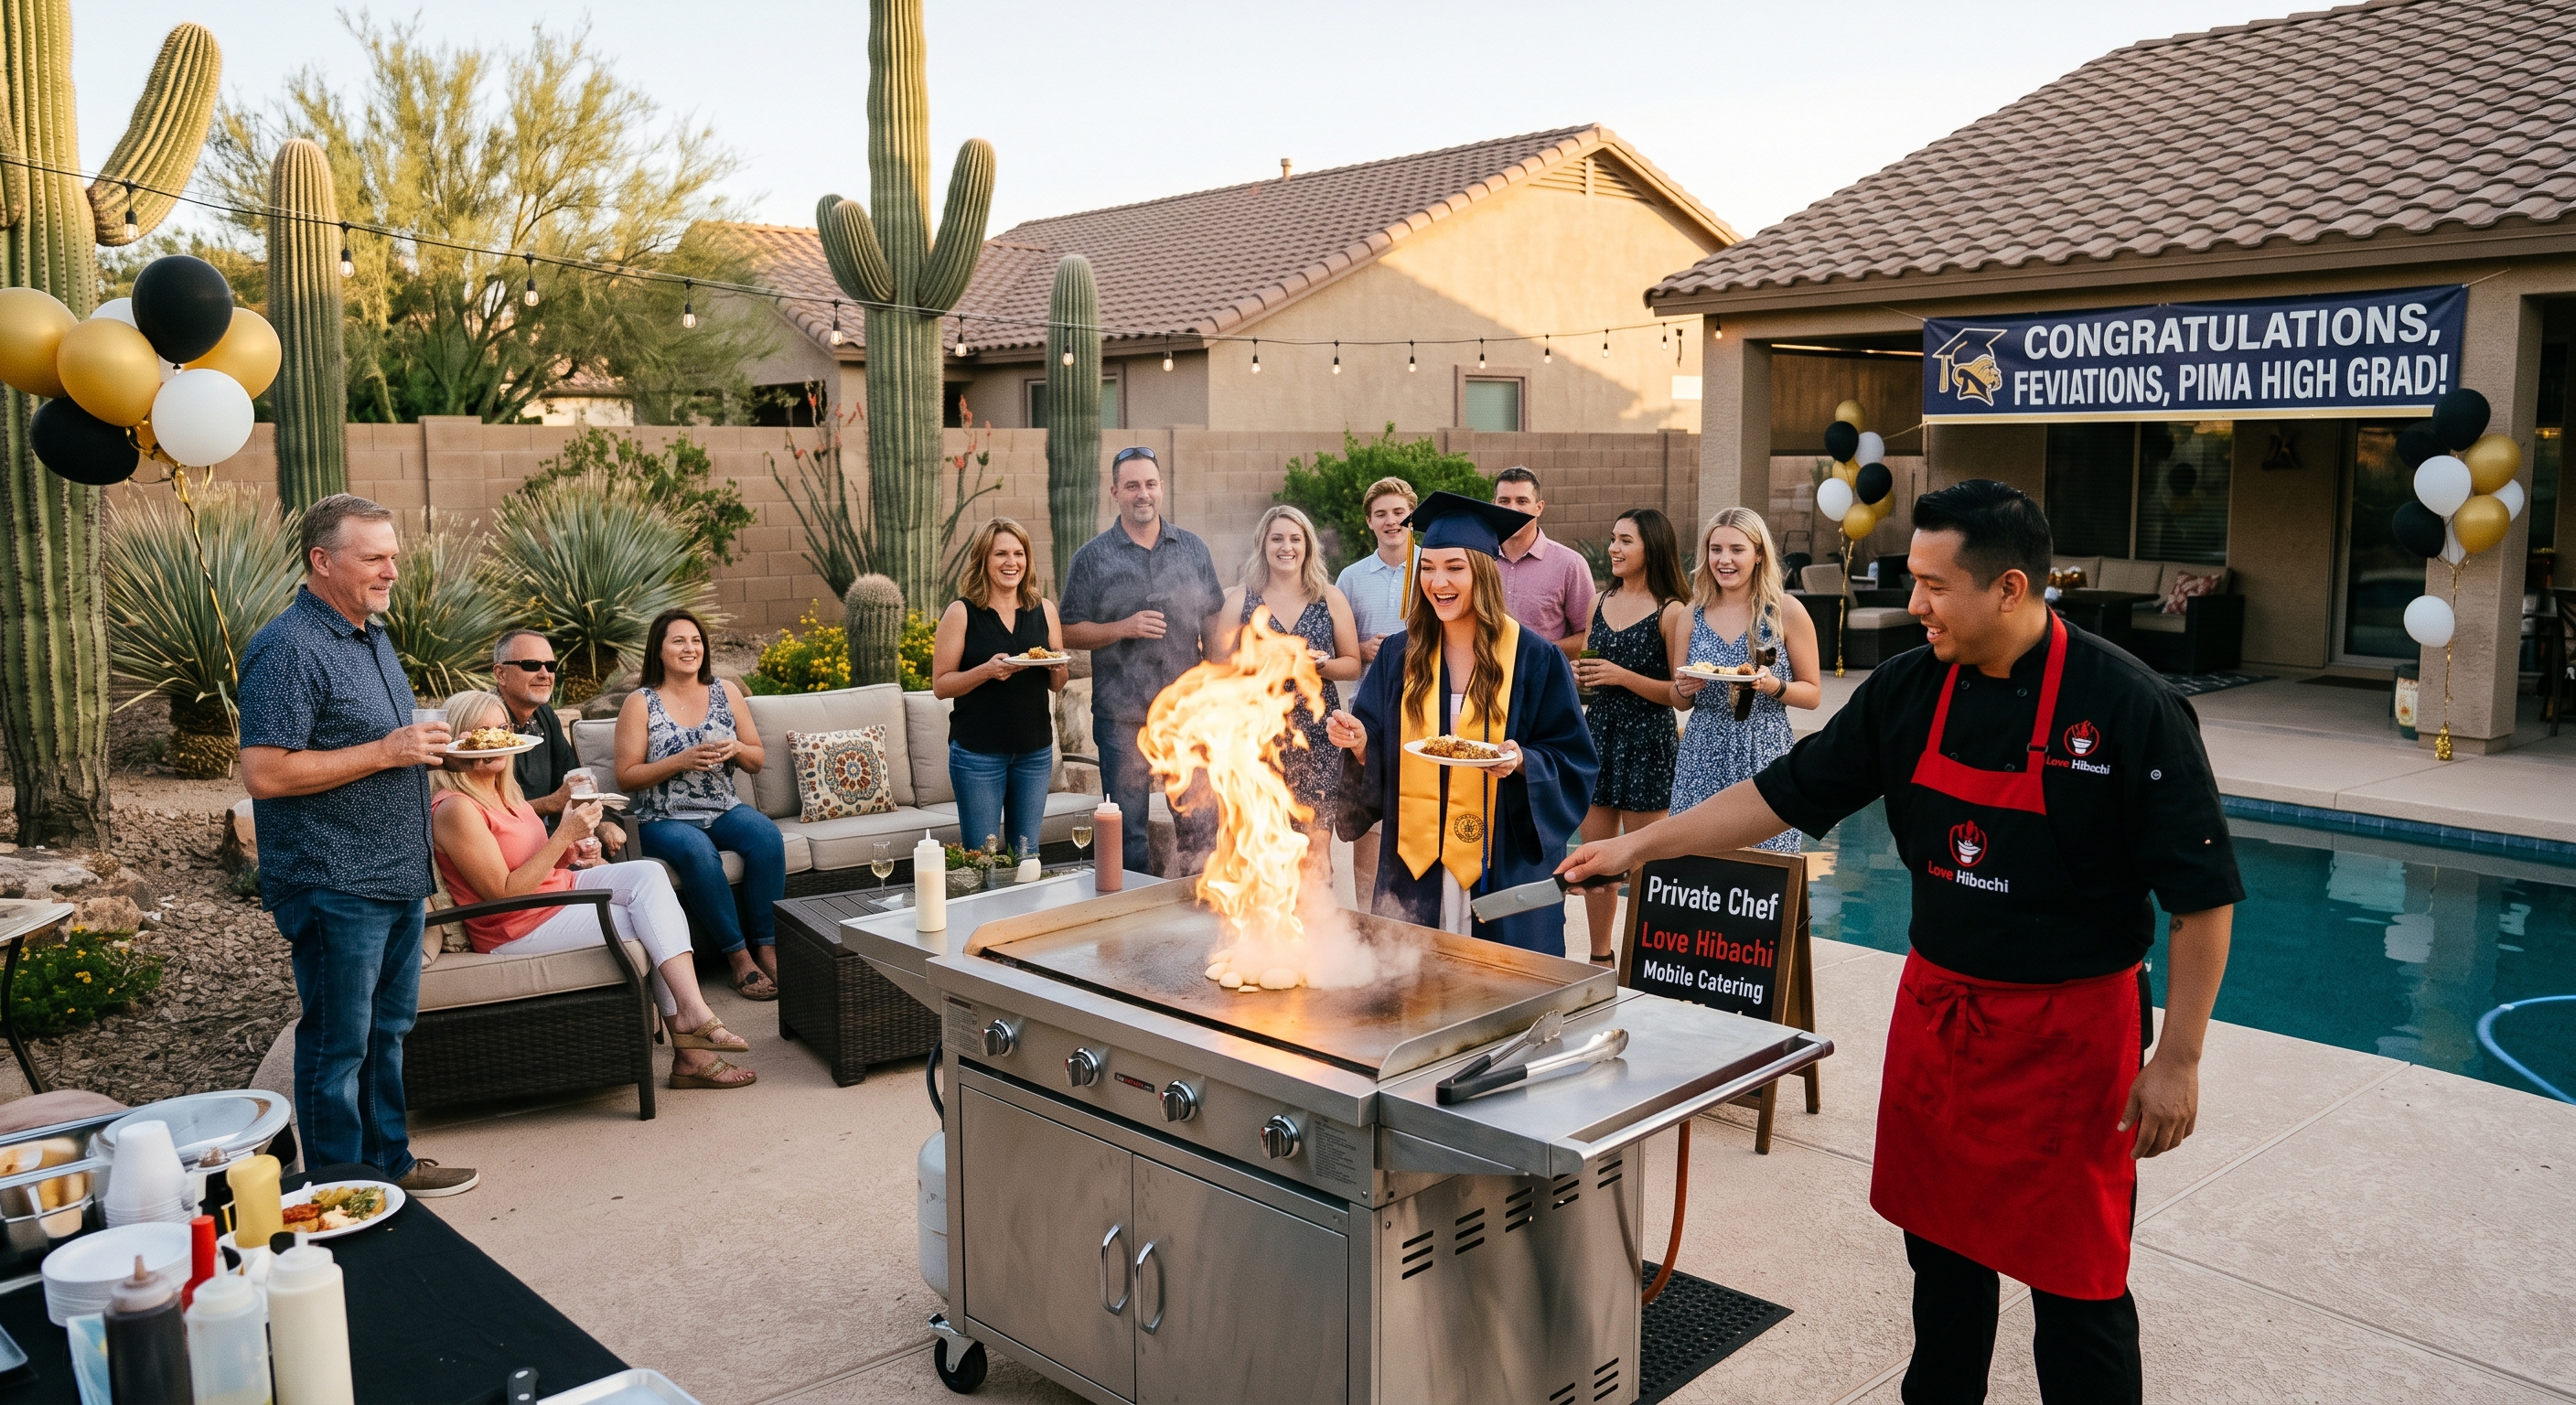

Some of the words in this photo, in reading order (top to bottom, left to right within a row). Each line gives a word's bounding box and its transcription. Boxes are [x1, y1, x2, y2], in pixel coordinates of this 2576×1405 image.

[2023, 303, 2441, 360] CONGRATULATIONS,
[2013, 366, 2171, 407] FEVIATIONS,
[2178, 362, 2253, 402] PIMA
[2260, 358, 2337, 400] HIGH
[2346, 353, 2449, 398] GRAD!
[2045, 755, 2070, 768] Love
[1648, 875, 1722, 913] Private
[1728, 887, 1779, 921] Chef
[1927, 860, 1955, 882] Love
[1956, 869, 2010, 894] Hibachi
[1641, 921, 1690, 954] Love
[1695, 929, 1775, 968] Hibachi
[1643, 959, 1693, 987] Mobile
[1698, 970, 1764, 1005] Catering
